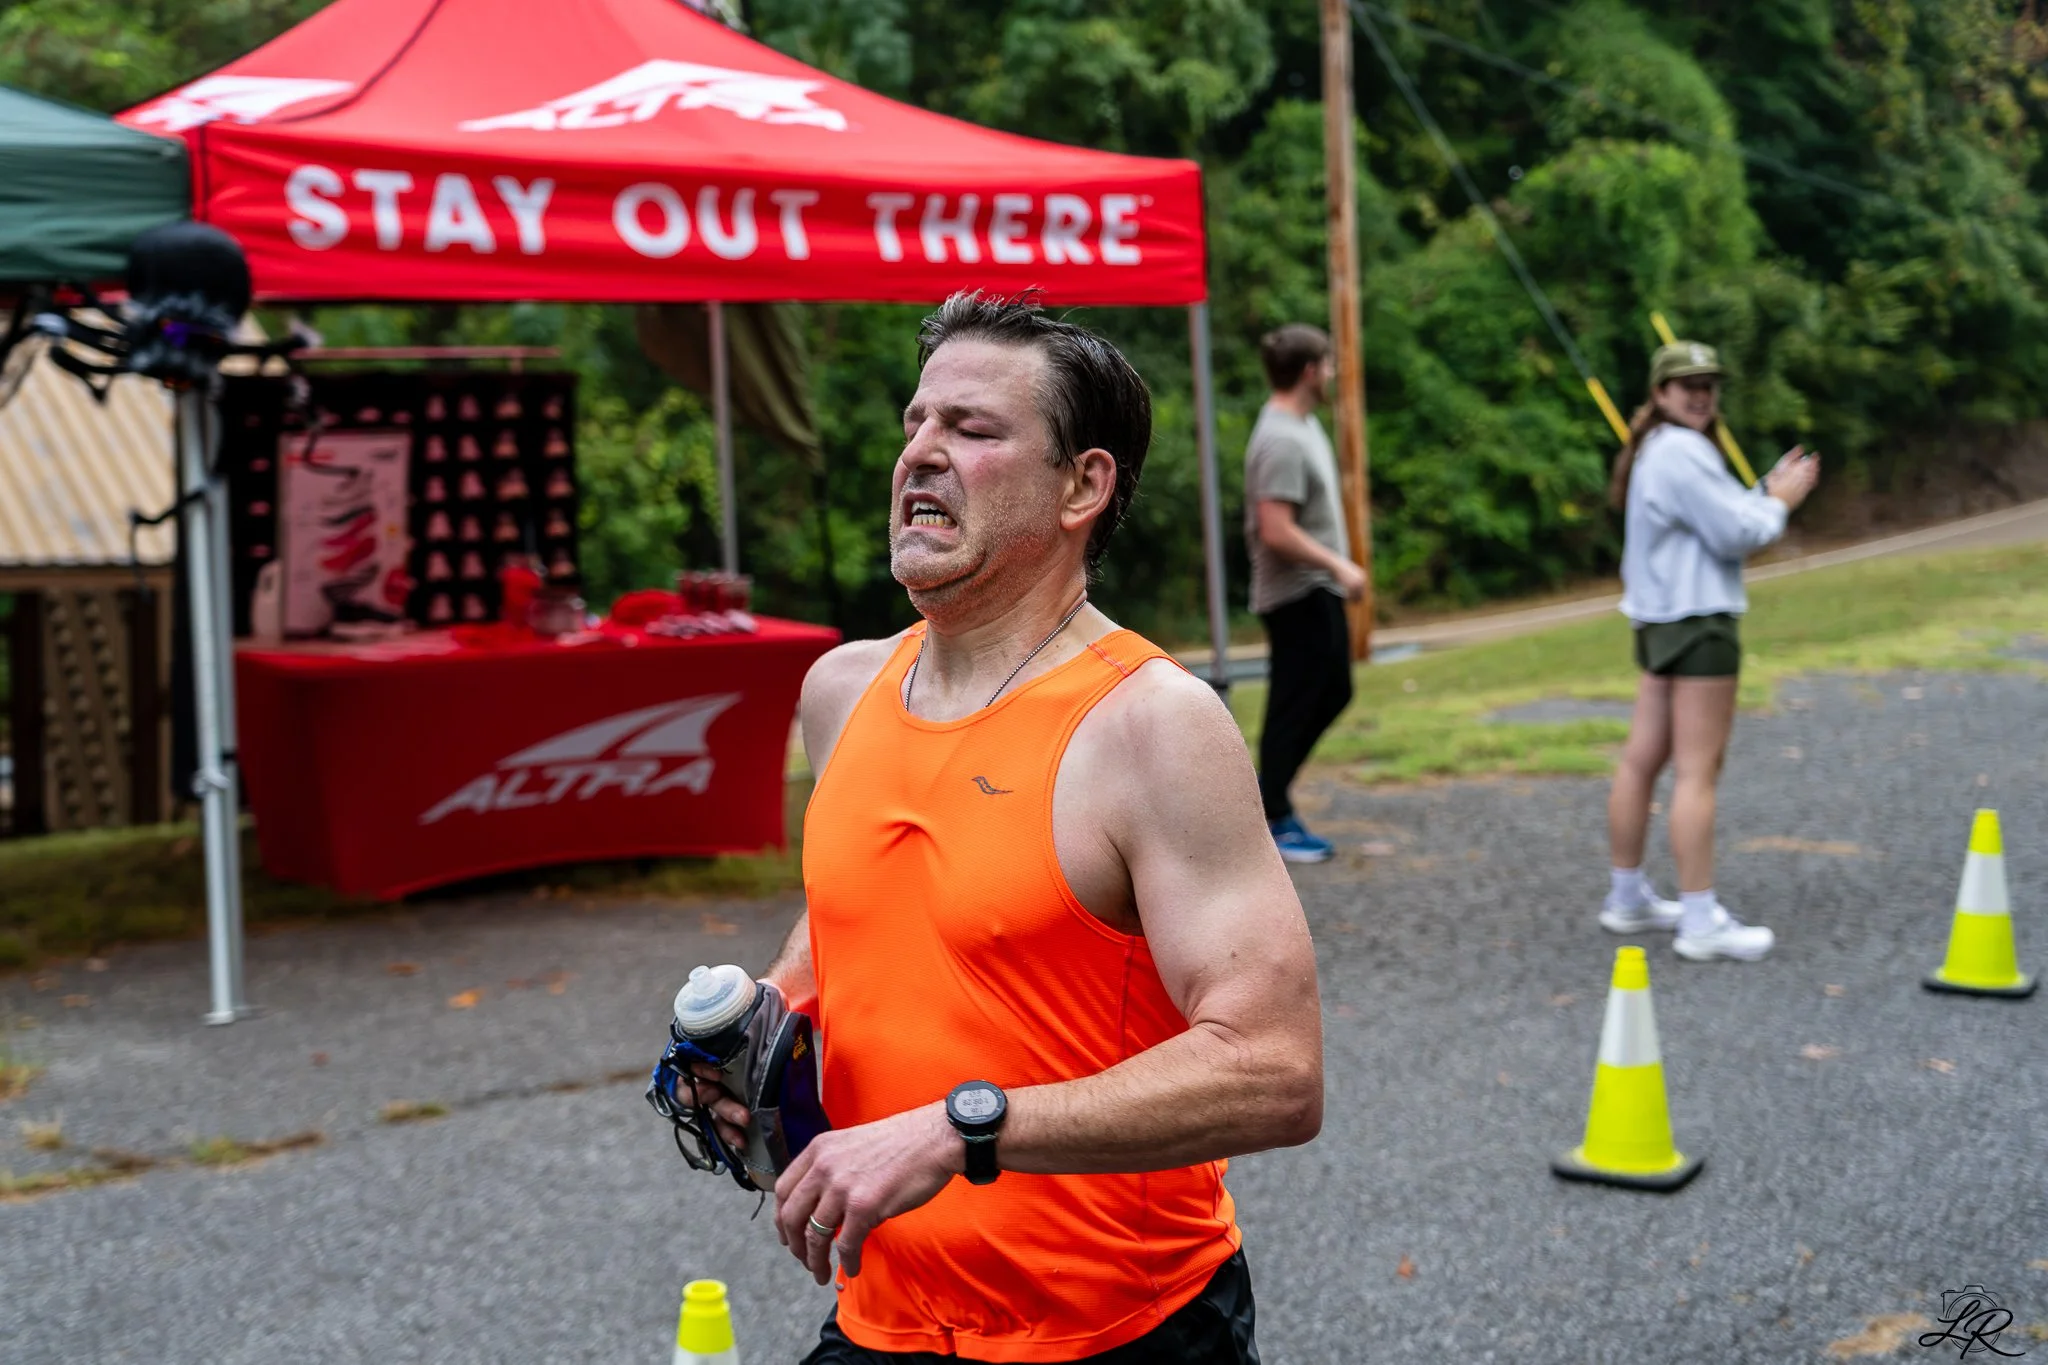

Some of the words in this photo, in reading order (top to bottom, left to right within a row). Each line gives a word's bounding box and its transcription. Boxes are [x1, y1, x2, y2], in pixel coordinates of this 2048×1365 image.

[284, 164, 556, 255] STAY
[612, 181, 820, 261] OUT
[866, 192, 1142, 266] THERE
[418, 756, 714, 826] ALTRA
